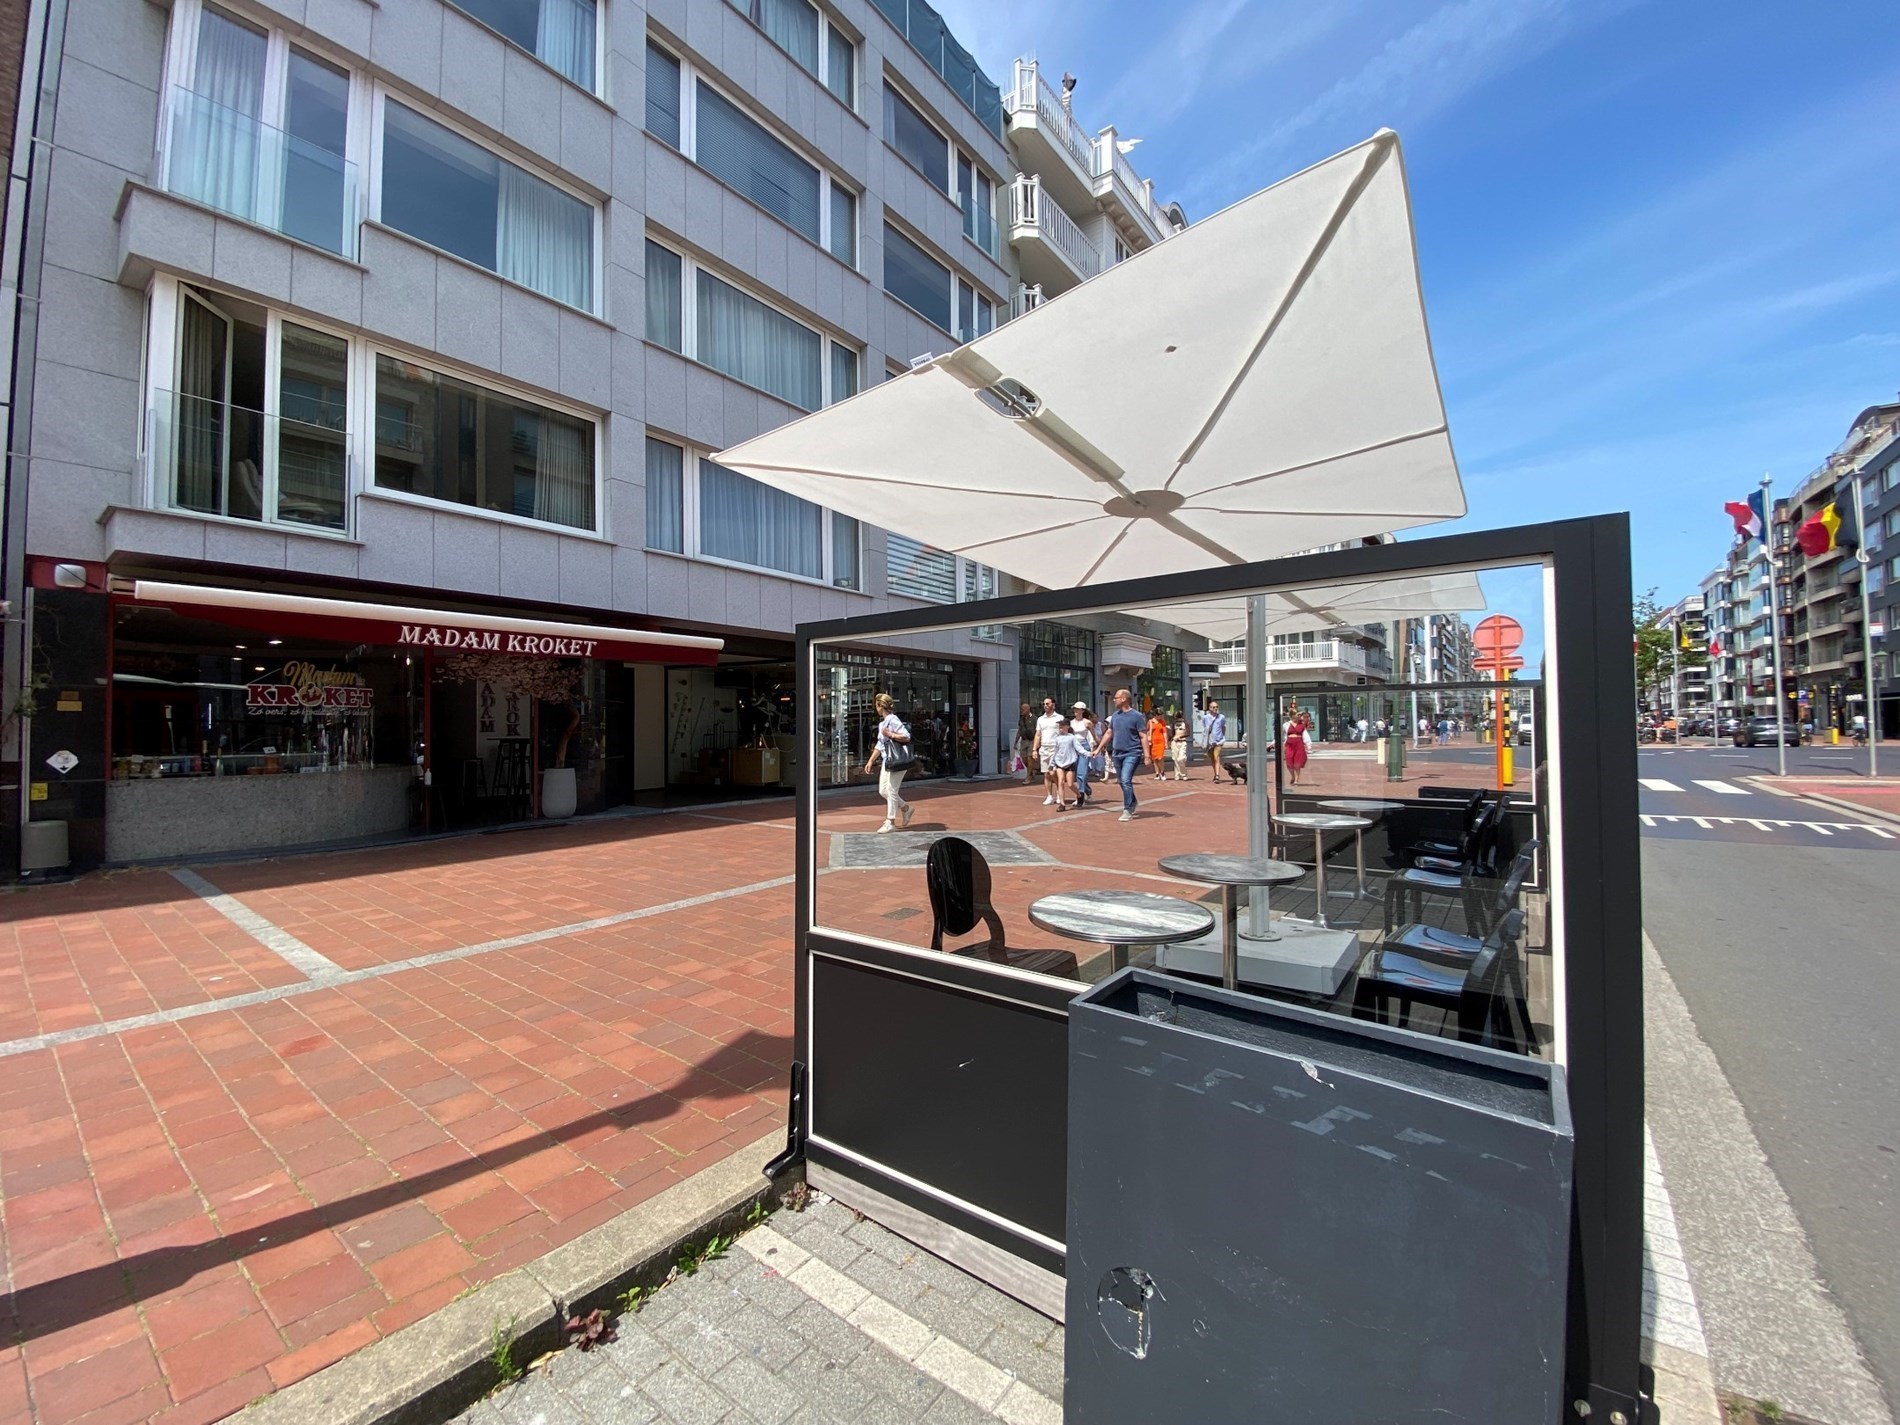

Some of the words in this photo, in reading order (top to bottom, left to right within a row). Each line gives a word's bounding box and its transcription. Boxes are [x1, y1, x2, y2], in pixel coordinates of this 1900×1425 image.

[397, 625, 501, 651] MADAM
[507, 634, 597, 657] KROKET
[480, 683, 496, 732] ADAM
[1798, 690, 1806, 698] P
